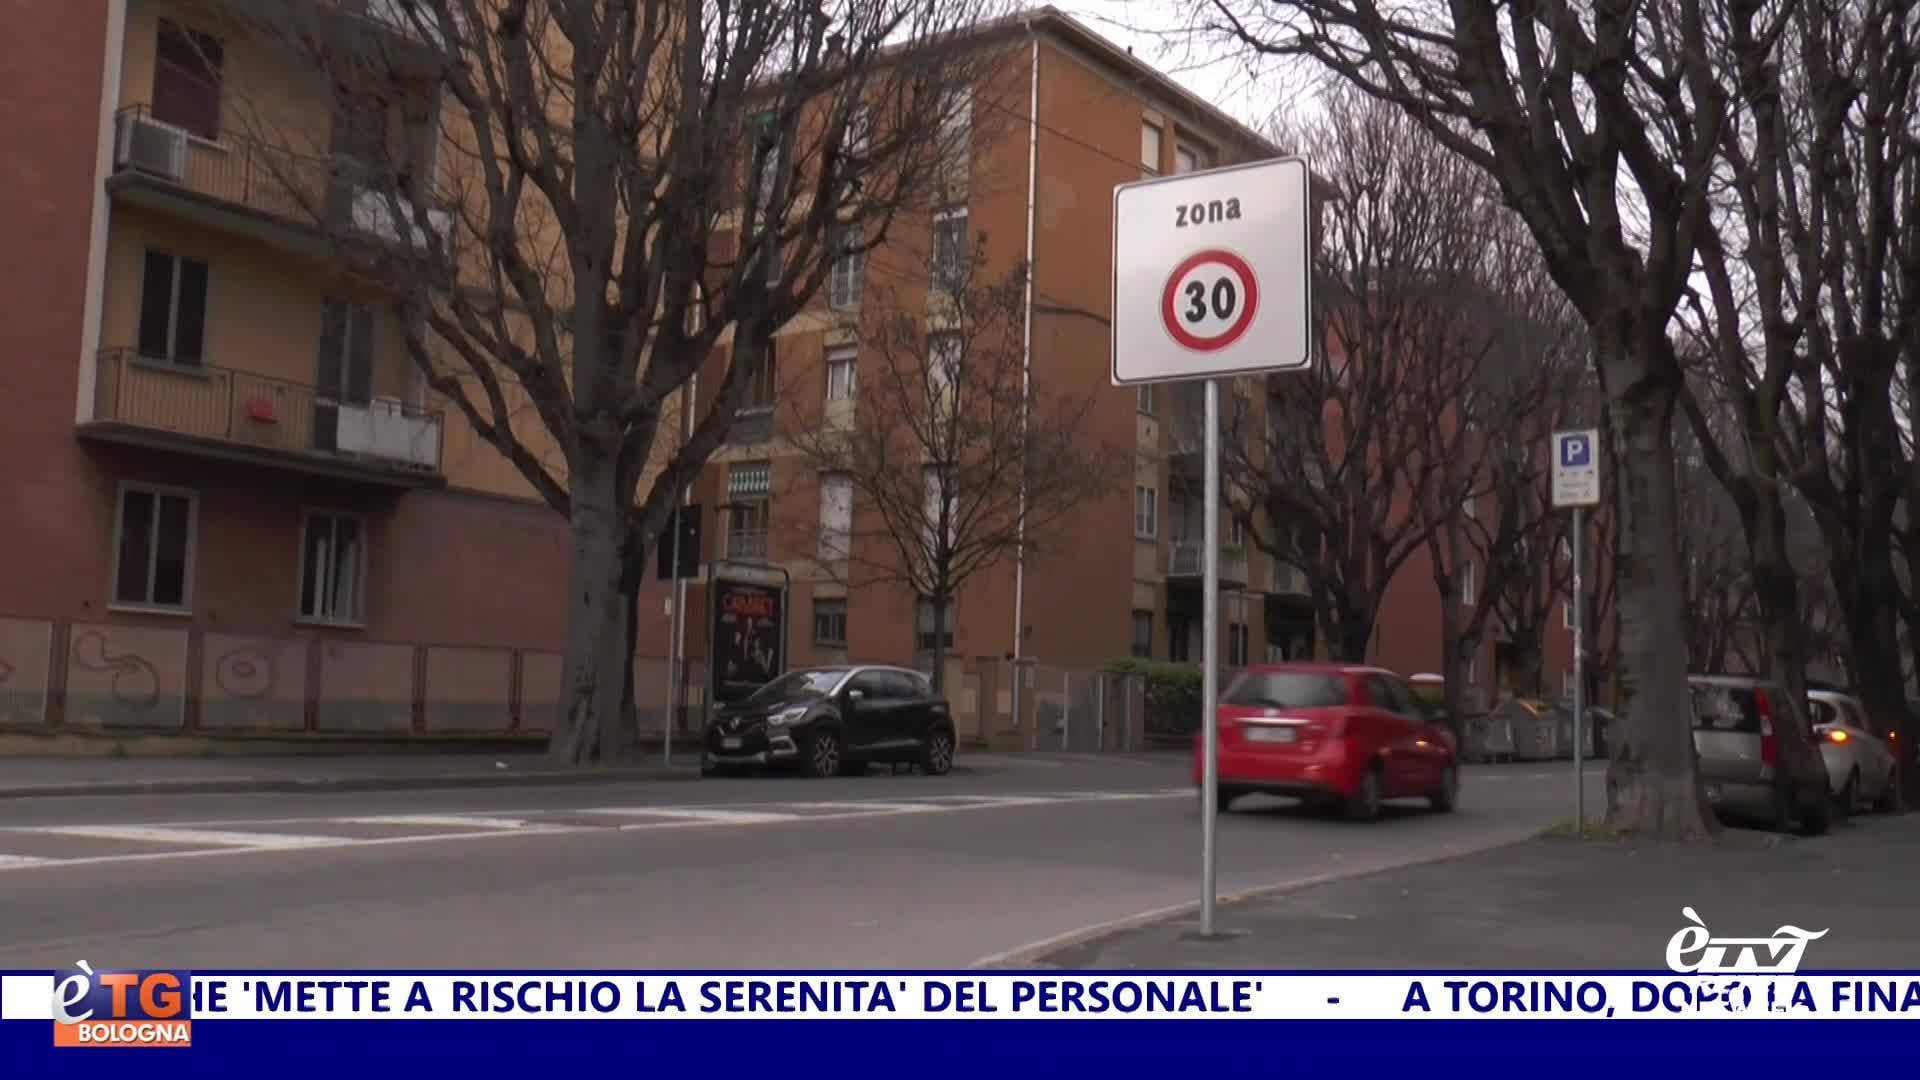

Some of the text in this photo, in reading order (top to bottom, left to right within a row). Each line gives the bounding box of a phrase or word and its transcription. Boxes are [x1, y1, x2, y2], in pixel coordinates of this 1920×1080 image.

[1175, 197, 1241, 228] zona
[1184, 276, 1237, 324] 30
[1567, 440, 1584, 462] P
